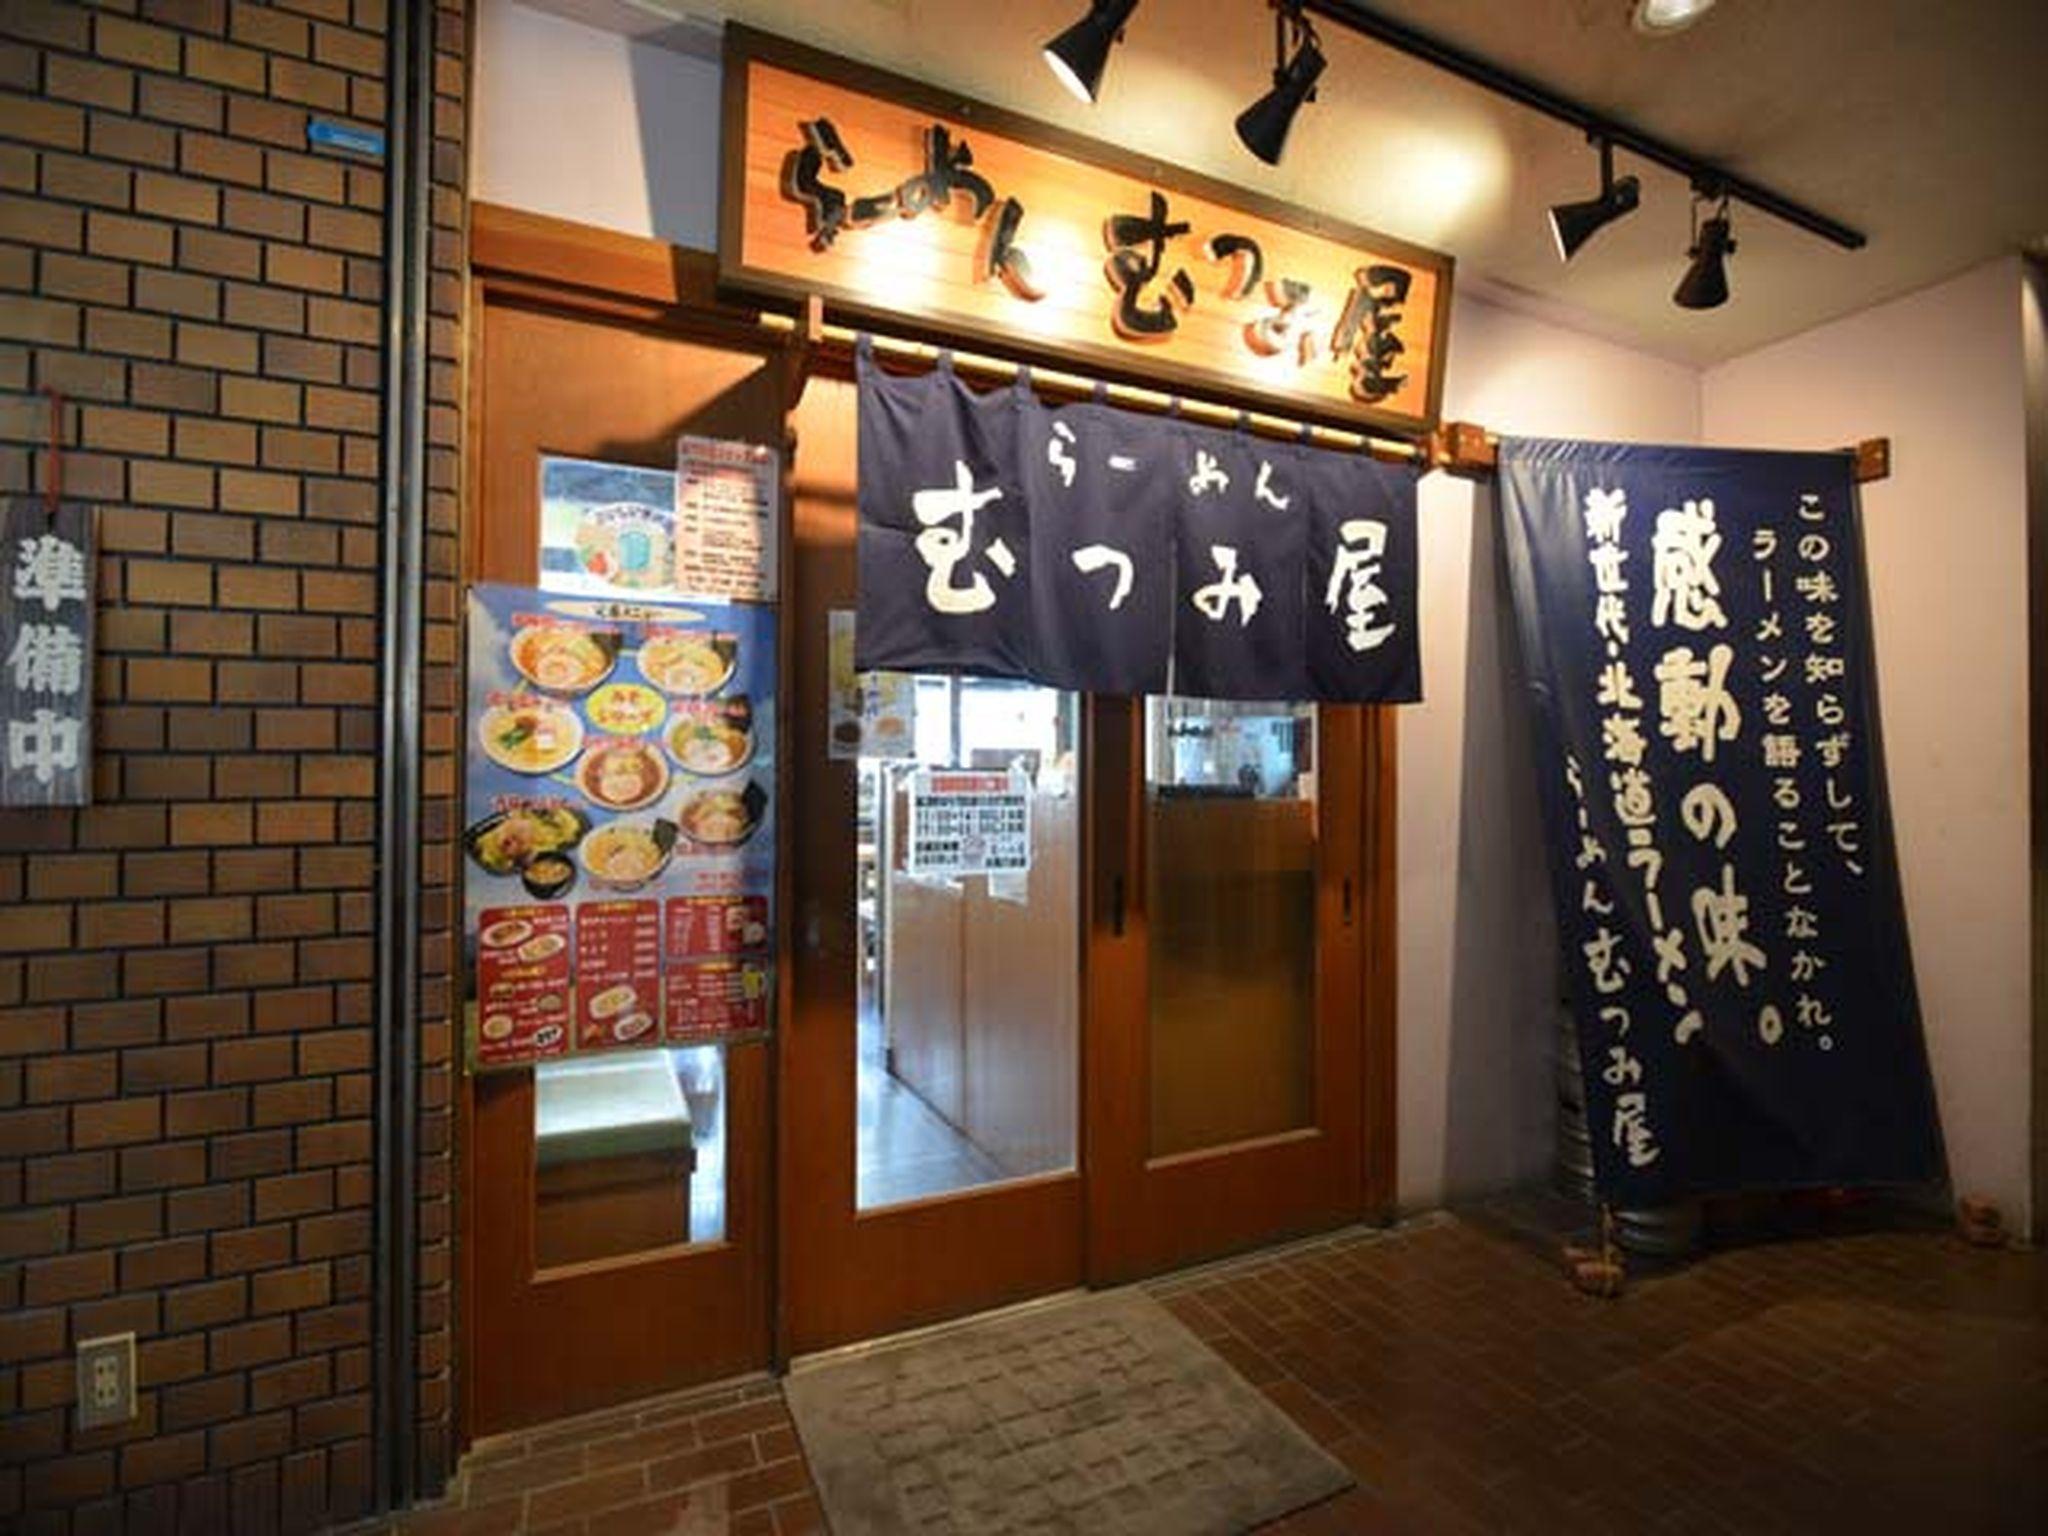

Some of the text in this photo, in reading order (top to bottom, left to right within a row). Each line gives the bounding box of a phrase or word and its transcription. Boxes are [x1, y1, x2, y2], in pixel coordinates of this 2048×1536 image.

[1101, 192, 1412, 404] むつみ屋
[5, 533, 88, 784] 準備中
[912, 460, 1397, 653] むつみ屋
[1796, 494, 1863, 875] この味を知らずして、
[1651, 498, 1785, 1045] 感動の味。
[1752, 529, 1833, 1051] ラーメンを語ることなかれ。
